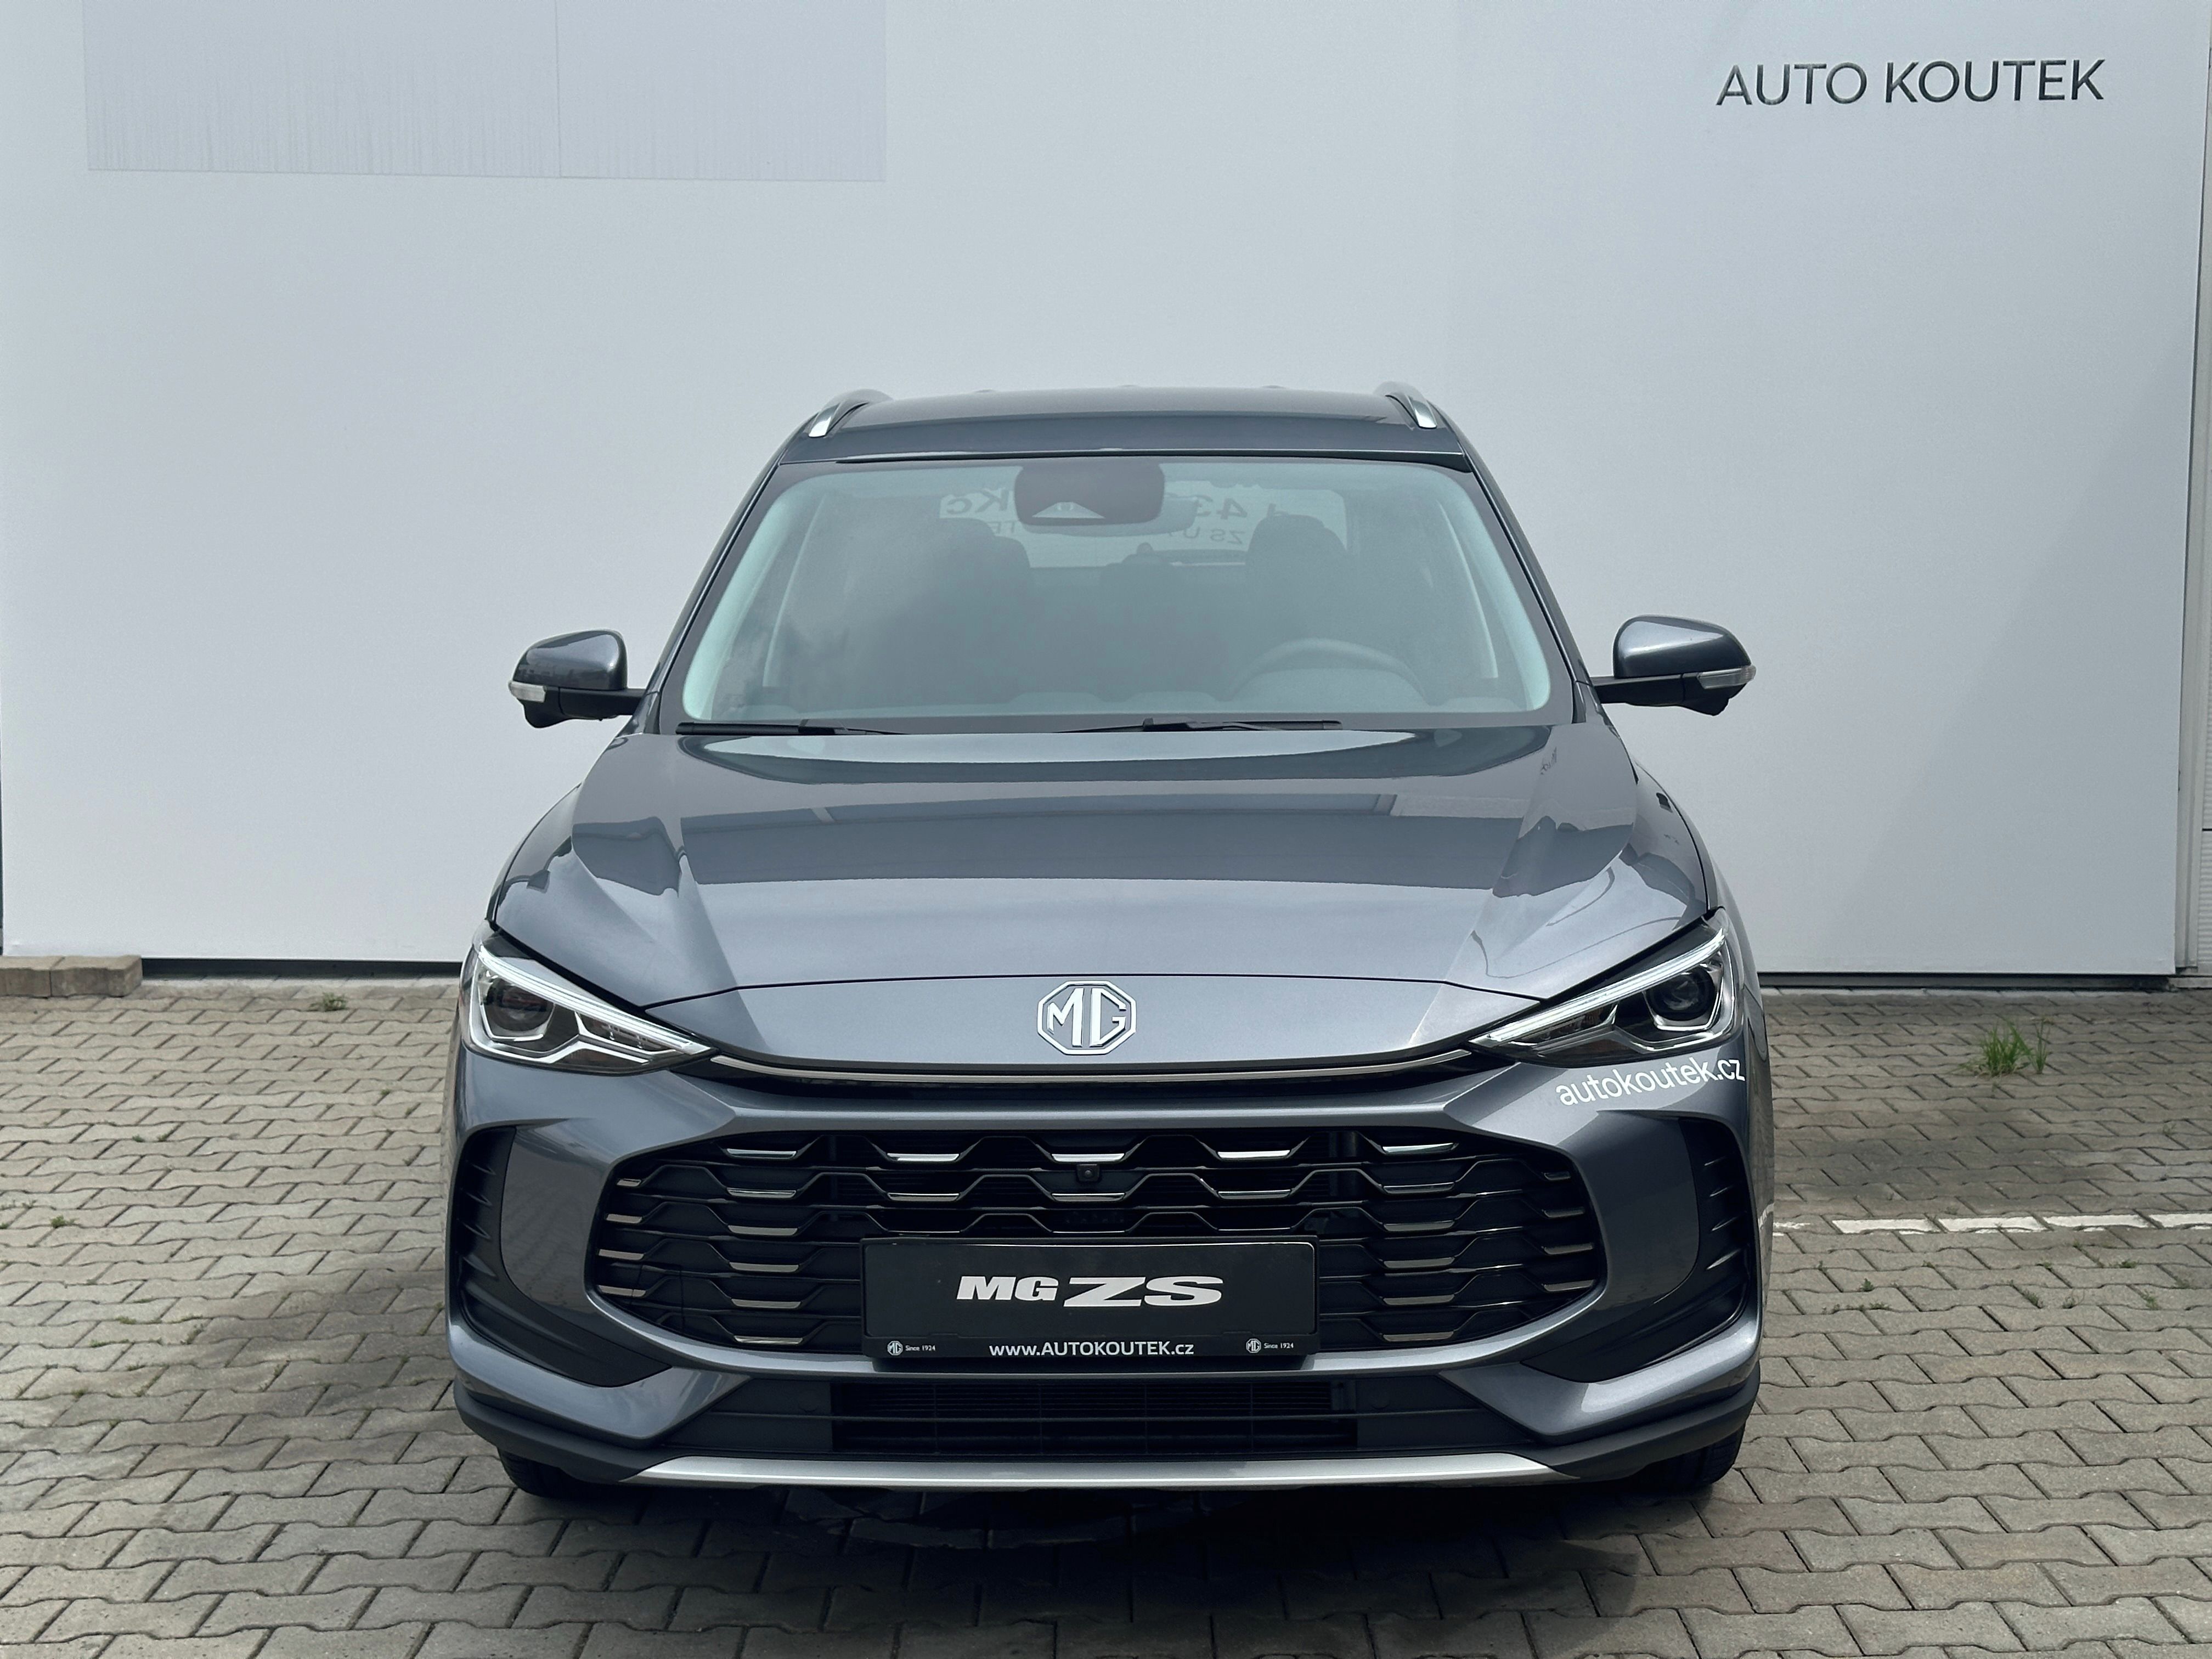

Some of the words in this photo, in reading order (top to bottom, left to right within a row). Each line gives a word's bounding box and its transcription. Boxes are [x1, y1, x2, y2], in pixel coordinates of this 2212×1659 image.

[1716, 63, 1867, 106] AUTO
[1884, 59, 2106, 104] KOUTEK
[1046, 986, 1128, 1048] MG
[1555, 1056, 1746, 1106] autokoutek.cz
[956, 1276, 1059, 1301] MG
[1063, 1276, 1224, 1307] ZS
[889, 1342, 902, 1355] MG
[989, 1340, 1195, 1356] www.AUTOKOUTEK.cz
[1247, 1340, 1261, 1352] MG
